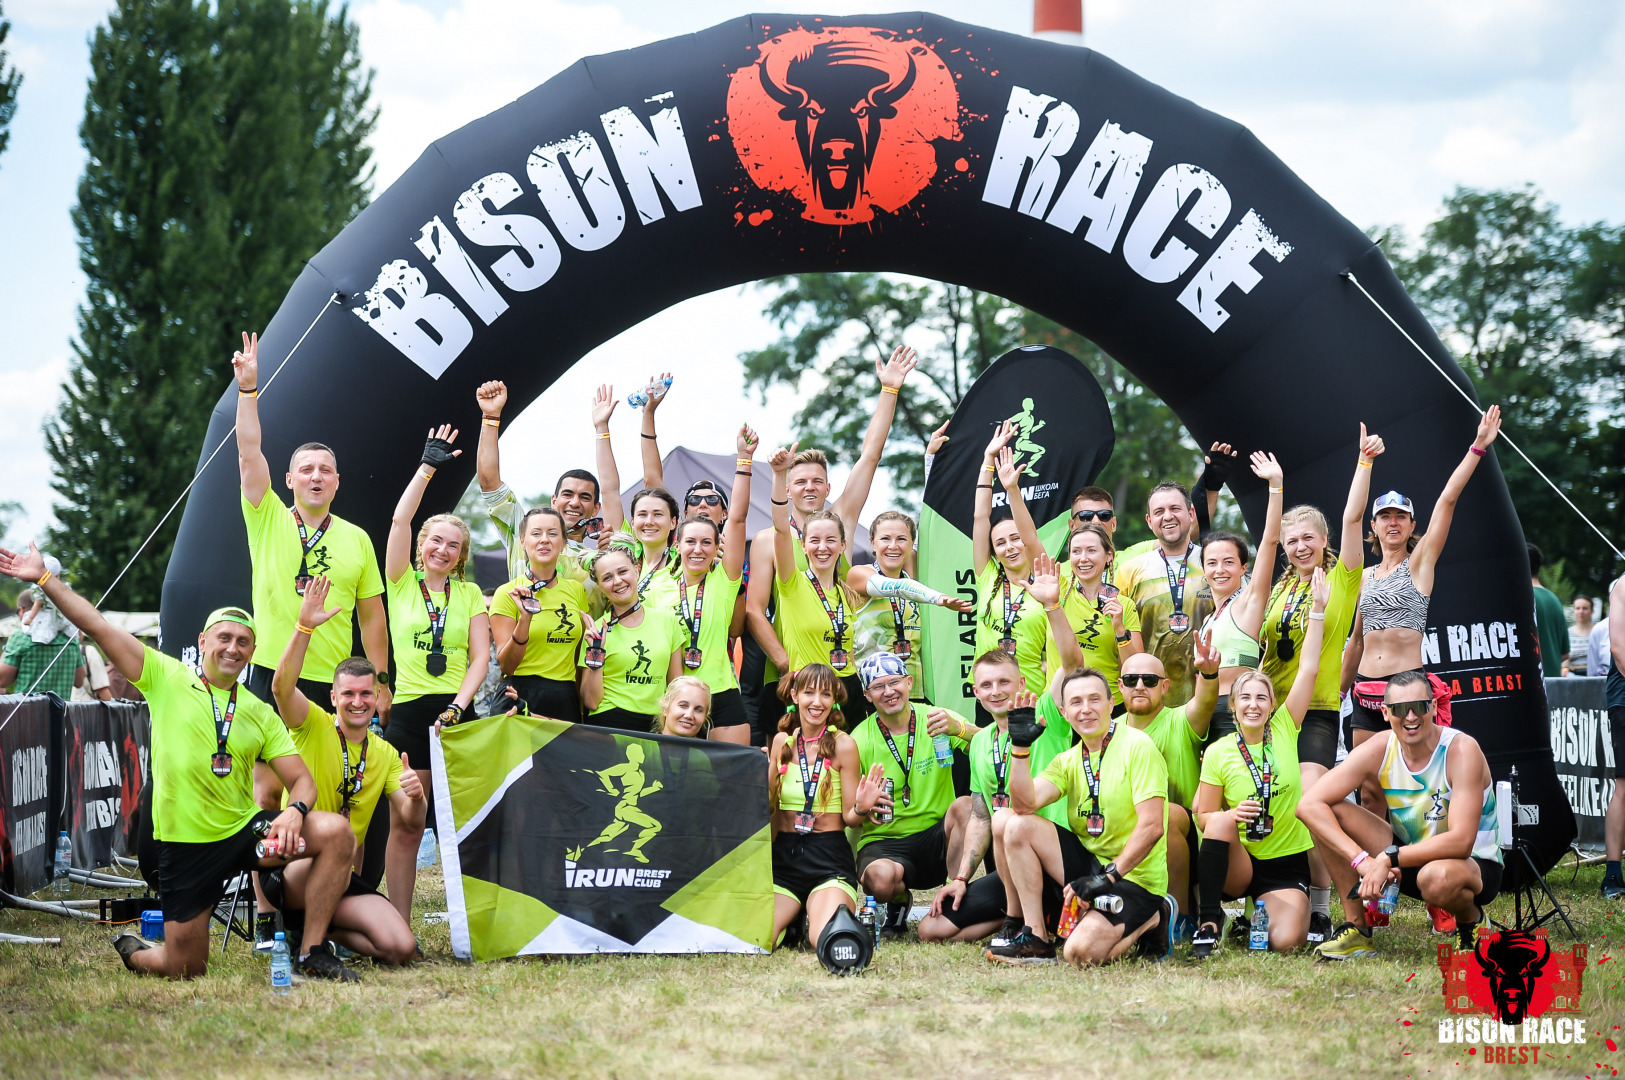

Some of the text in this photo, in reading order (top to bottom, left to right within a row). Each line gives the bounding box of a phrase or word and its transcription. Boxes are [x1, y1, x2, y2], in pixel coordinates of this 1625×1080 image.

[351, 85, 1295, 381] BISON RACE
[992, 486, 1035, 508] RN
[1034, 491, 1050, 500] БЕГА
[1035, 482, 1059, 492] ШКОЛА
[414, 636, 444, 653] iRU
[1446, 621, 1521, 662] RACE
[1452, 674, 1522, 695] A BEAST
[1551, 707, 1598, 766] BISON
[565, 860, 672, 888] iRUN BREST
[634, 879, 662, 888] CLUB
[834, 946, 856, 960] JBL
